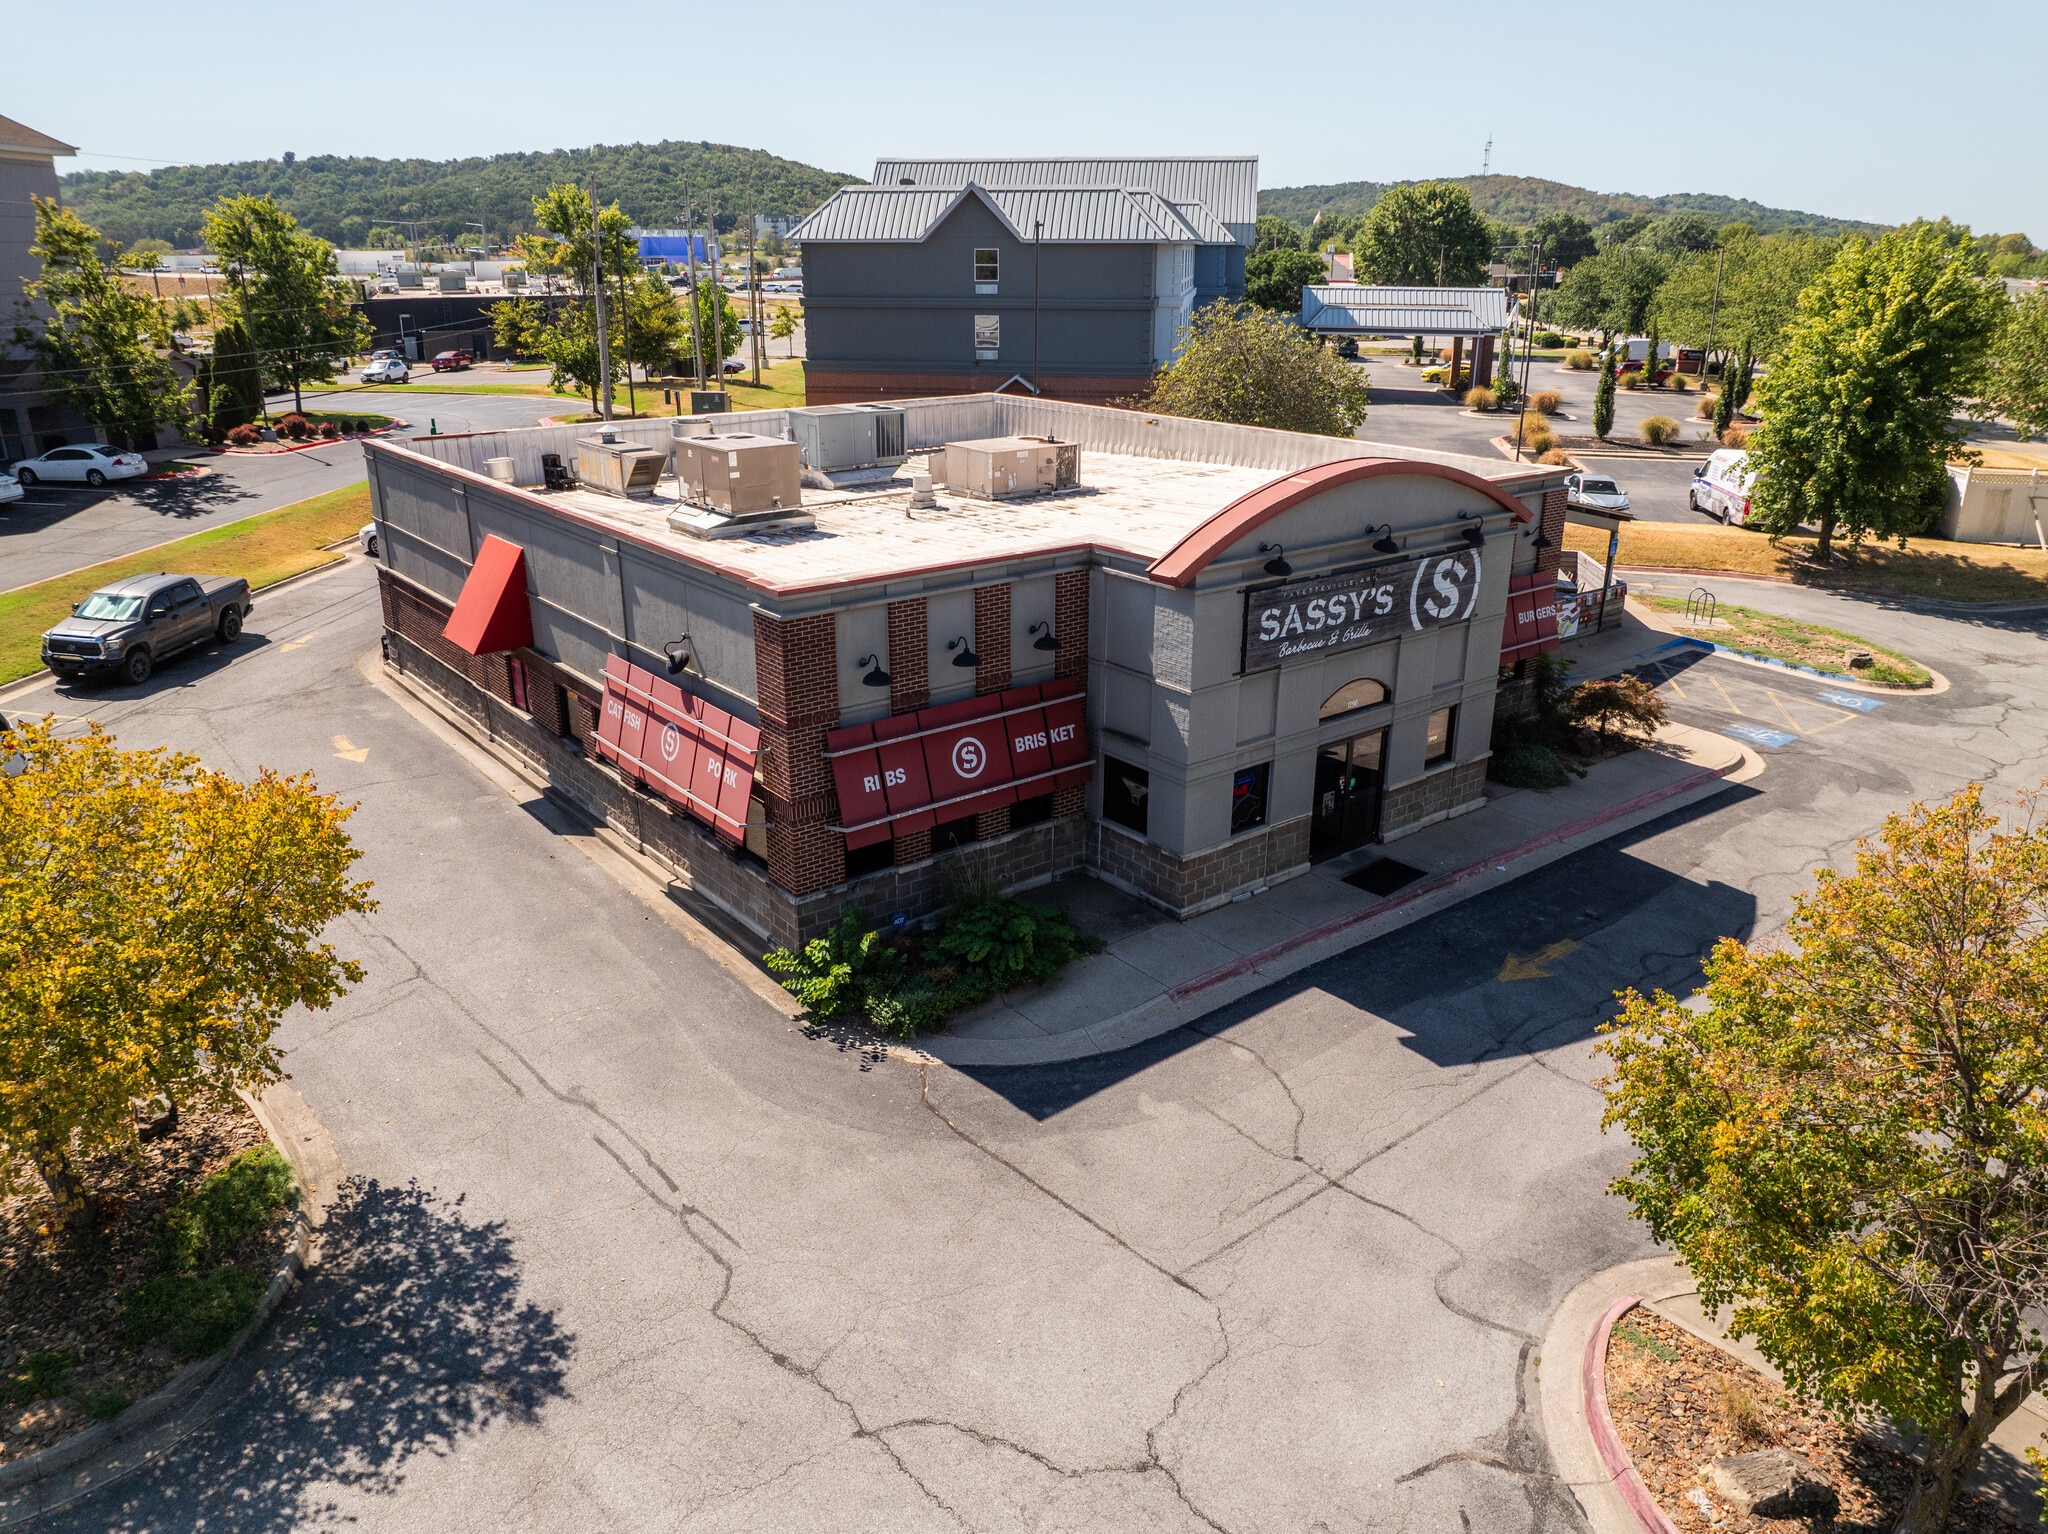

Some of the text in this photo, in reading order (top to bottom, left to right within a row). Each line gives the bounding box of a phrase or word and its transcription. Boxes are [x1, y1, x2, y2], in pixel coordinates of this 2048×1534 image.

[1259, 584, 1394, 641] SASSY'S
[1518, 605, 1556, 625] BURGERS
[1278, 622, 1372, 658] Barbecue & Grille
[1014, 724, 1076, 753] BRISKET
[707, 758, 738, 789] PORK
[863, 768, 907, 793] RIBS
